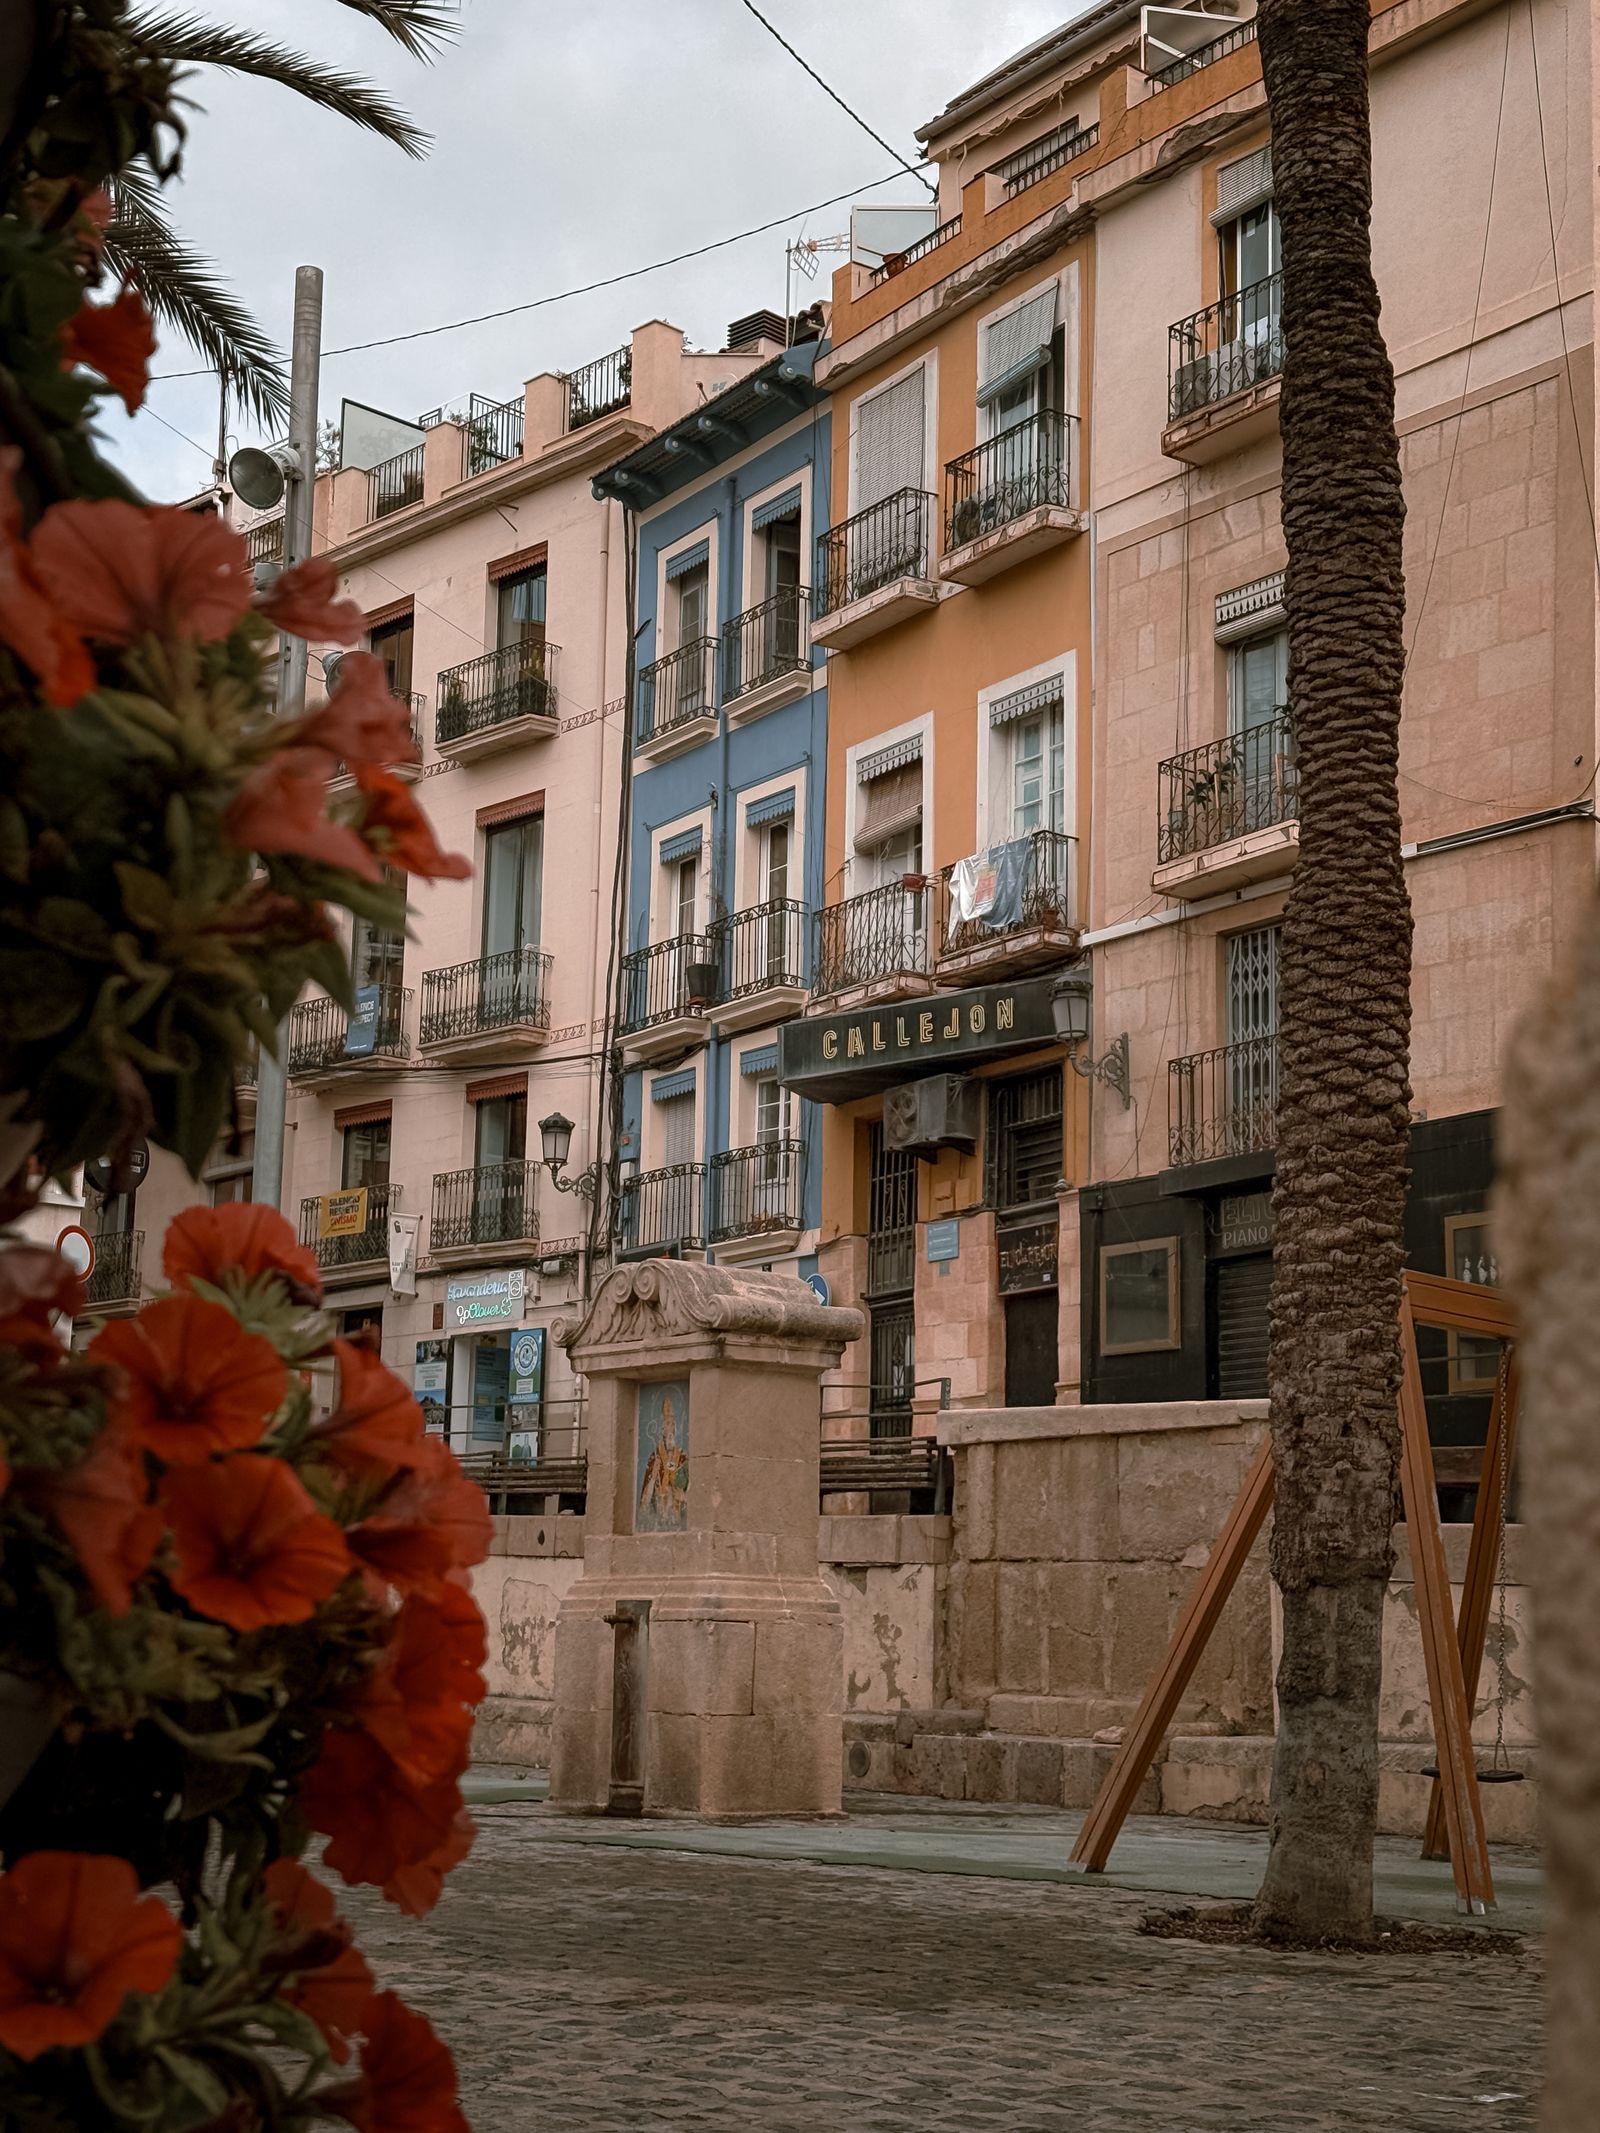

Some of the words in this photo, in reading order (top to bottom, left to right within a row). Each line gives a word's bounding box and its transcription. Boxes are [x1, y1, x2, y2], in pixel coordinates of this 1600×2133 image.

[822, 997, 1014, 1059] CALLEJON
[329, 1195, 360, 1207] SILENCIO
[1222, 1226, 1268, 1249] PIANO
